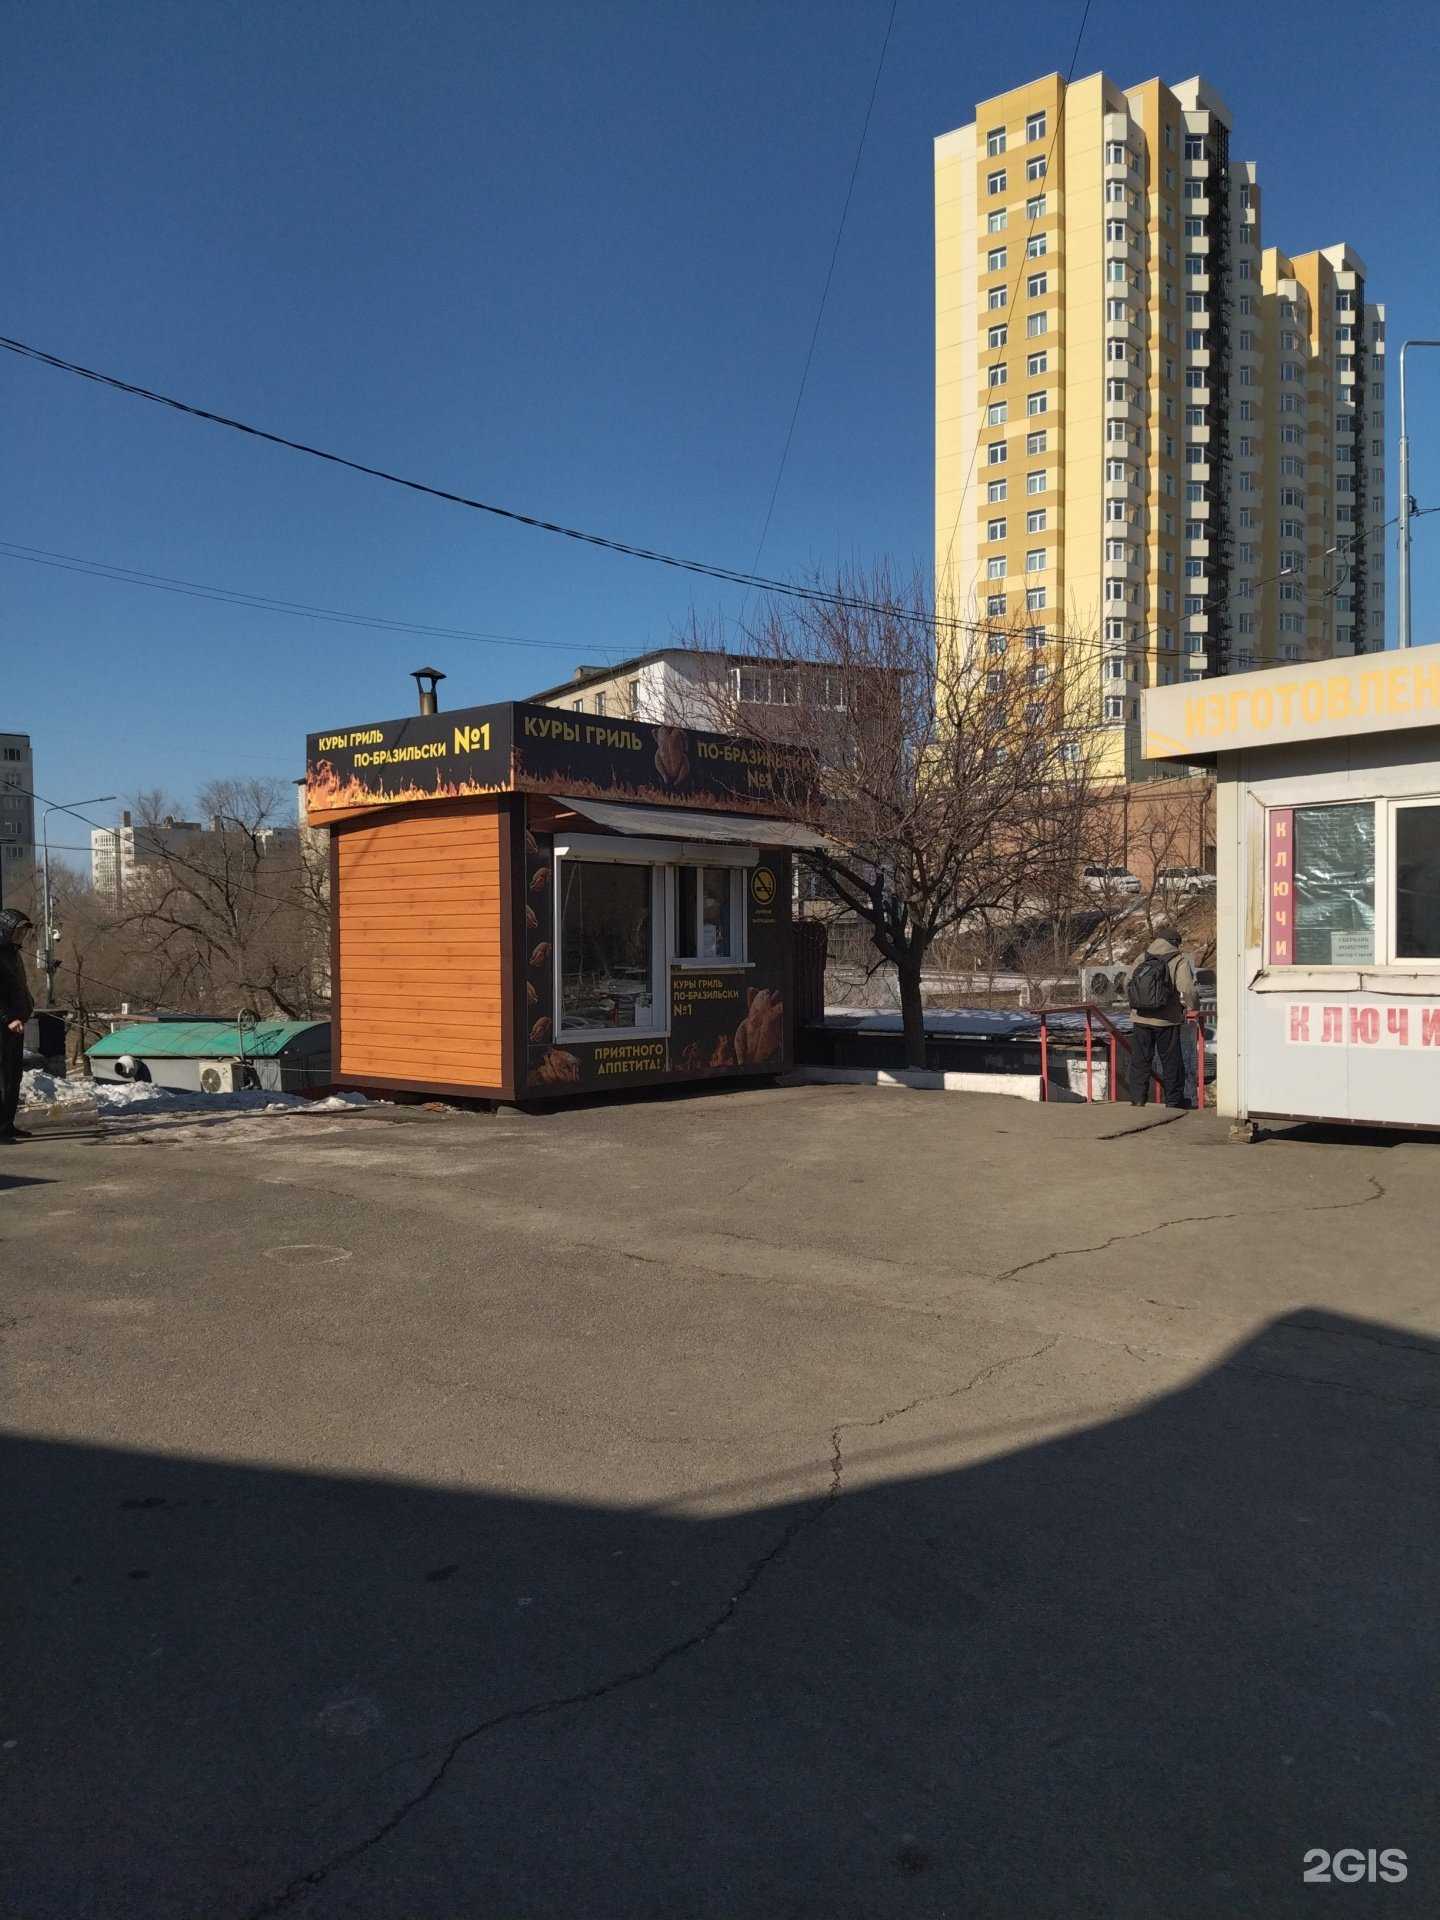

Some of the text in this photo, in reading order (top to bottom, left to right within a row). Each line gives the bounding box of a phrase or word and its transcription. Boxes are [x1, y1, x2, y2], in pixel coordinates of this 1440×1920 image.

[1183, 661, 1440, 737] ИЗГОТОВЛЕН
[318, 729, 384, 751] КУРЫ ГРИЛЬ
[453, 723, 490, 754] №1
[524, 716, 643, 750] КУРЫ ГРИЛЬ
[353, 742, 447, 768] ПО-БРАЗИЛЬСКИ
[673, 979, 723, 989] КУРЫ ГРИЛЬ
[673, 990, 739, 1001] ПО-БРАЗИЛЬСКИ
[1289, 1006, 1440, 1046] КЛЮЧИ
[594, 1044, 664, 1060] ПРИЯТНОГО
[598, 1058, 661, 1075] АППЕТИТА!
